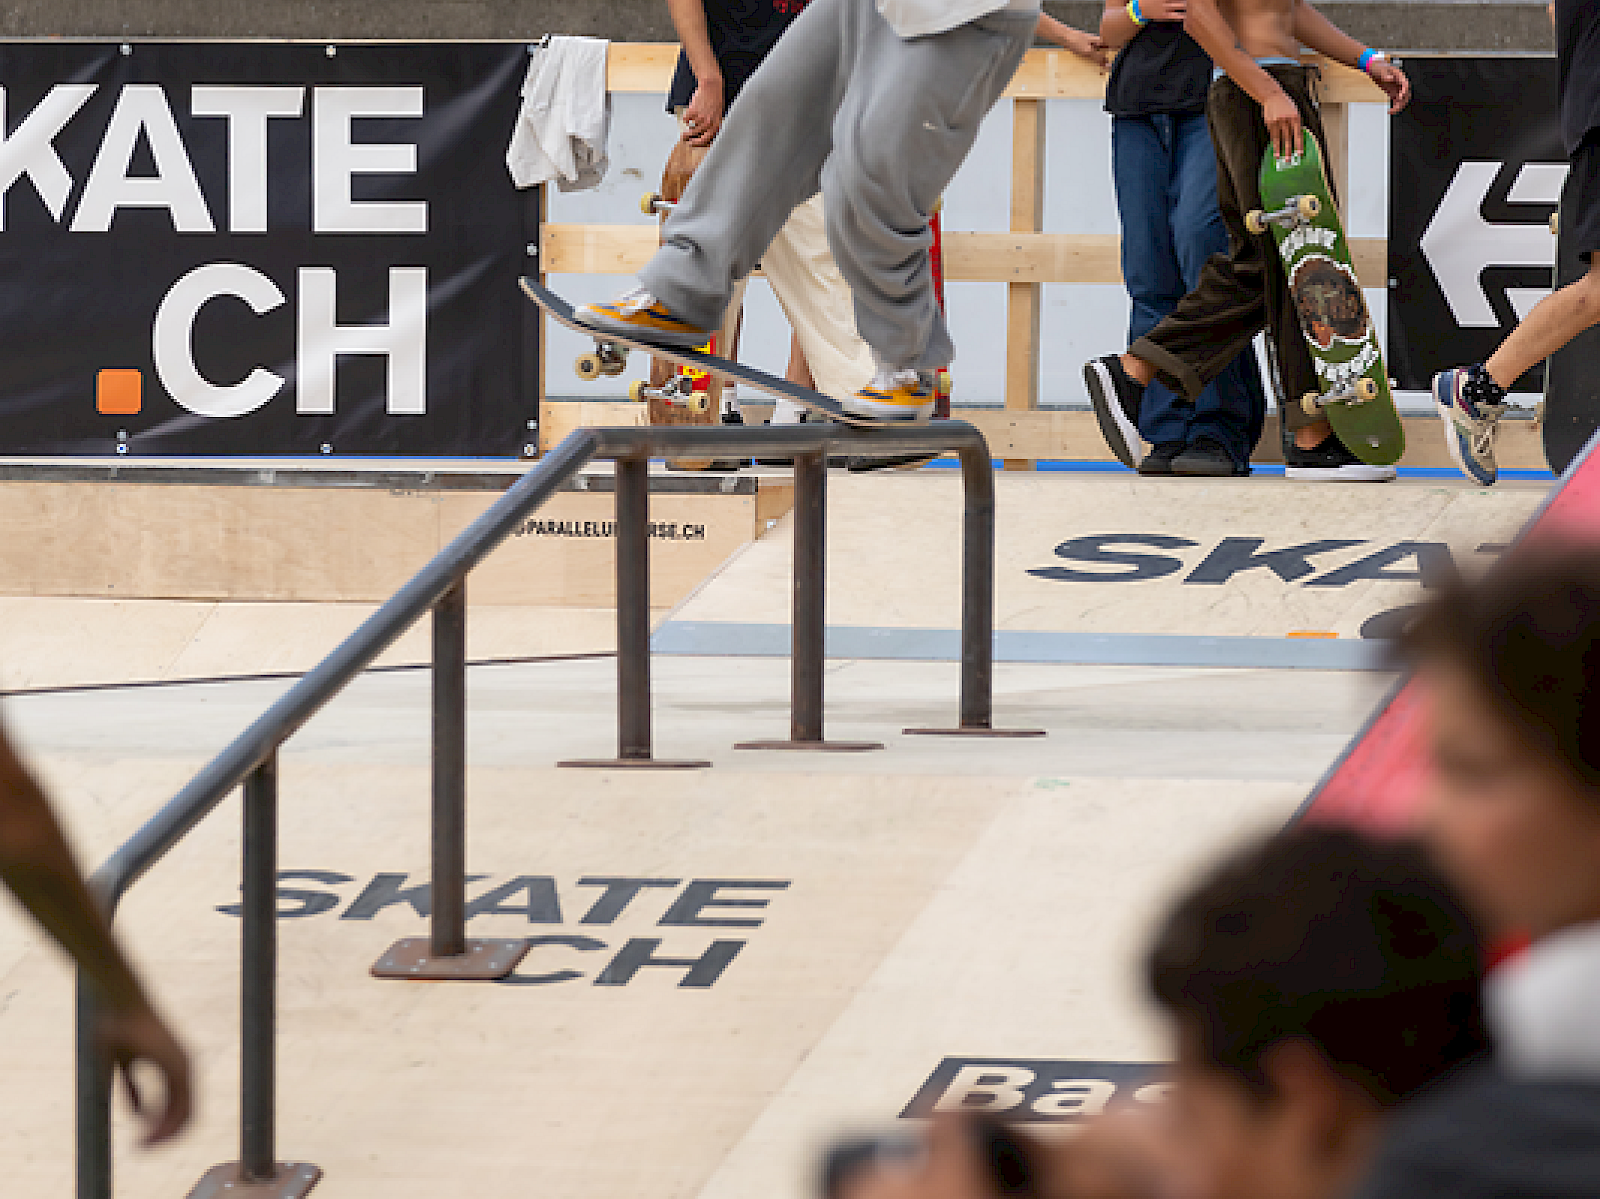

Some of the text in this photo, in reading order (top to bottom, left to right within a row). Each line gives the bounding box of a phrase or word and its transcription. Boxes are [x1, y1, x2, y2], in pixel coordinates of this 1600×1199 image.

[1025, 533, 1512, 588] SKA
[215, 869, 792, 928] SKATE
[440, 934, 748, 989] CH
